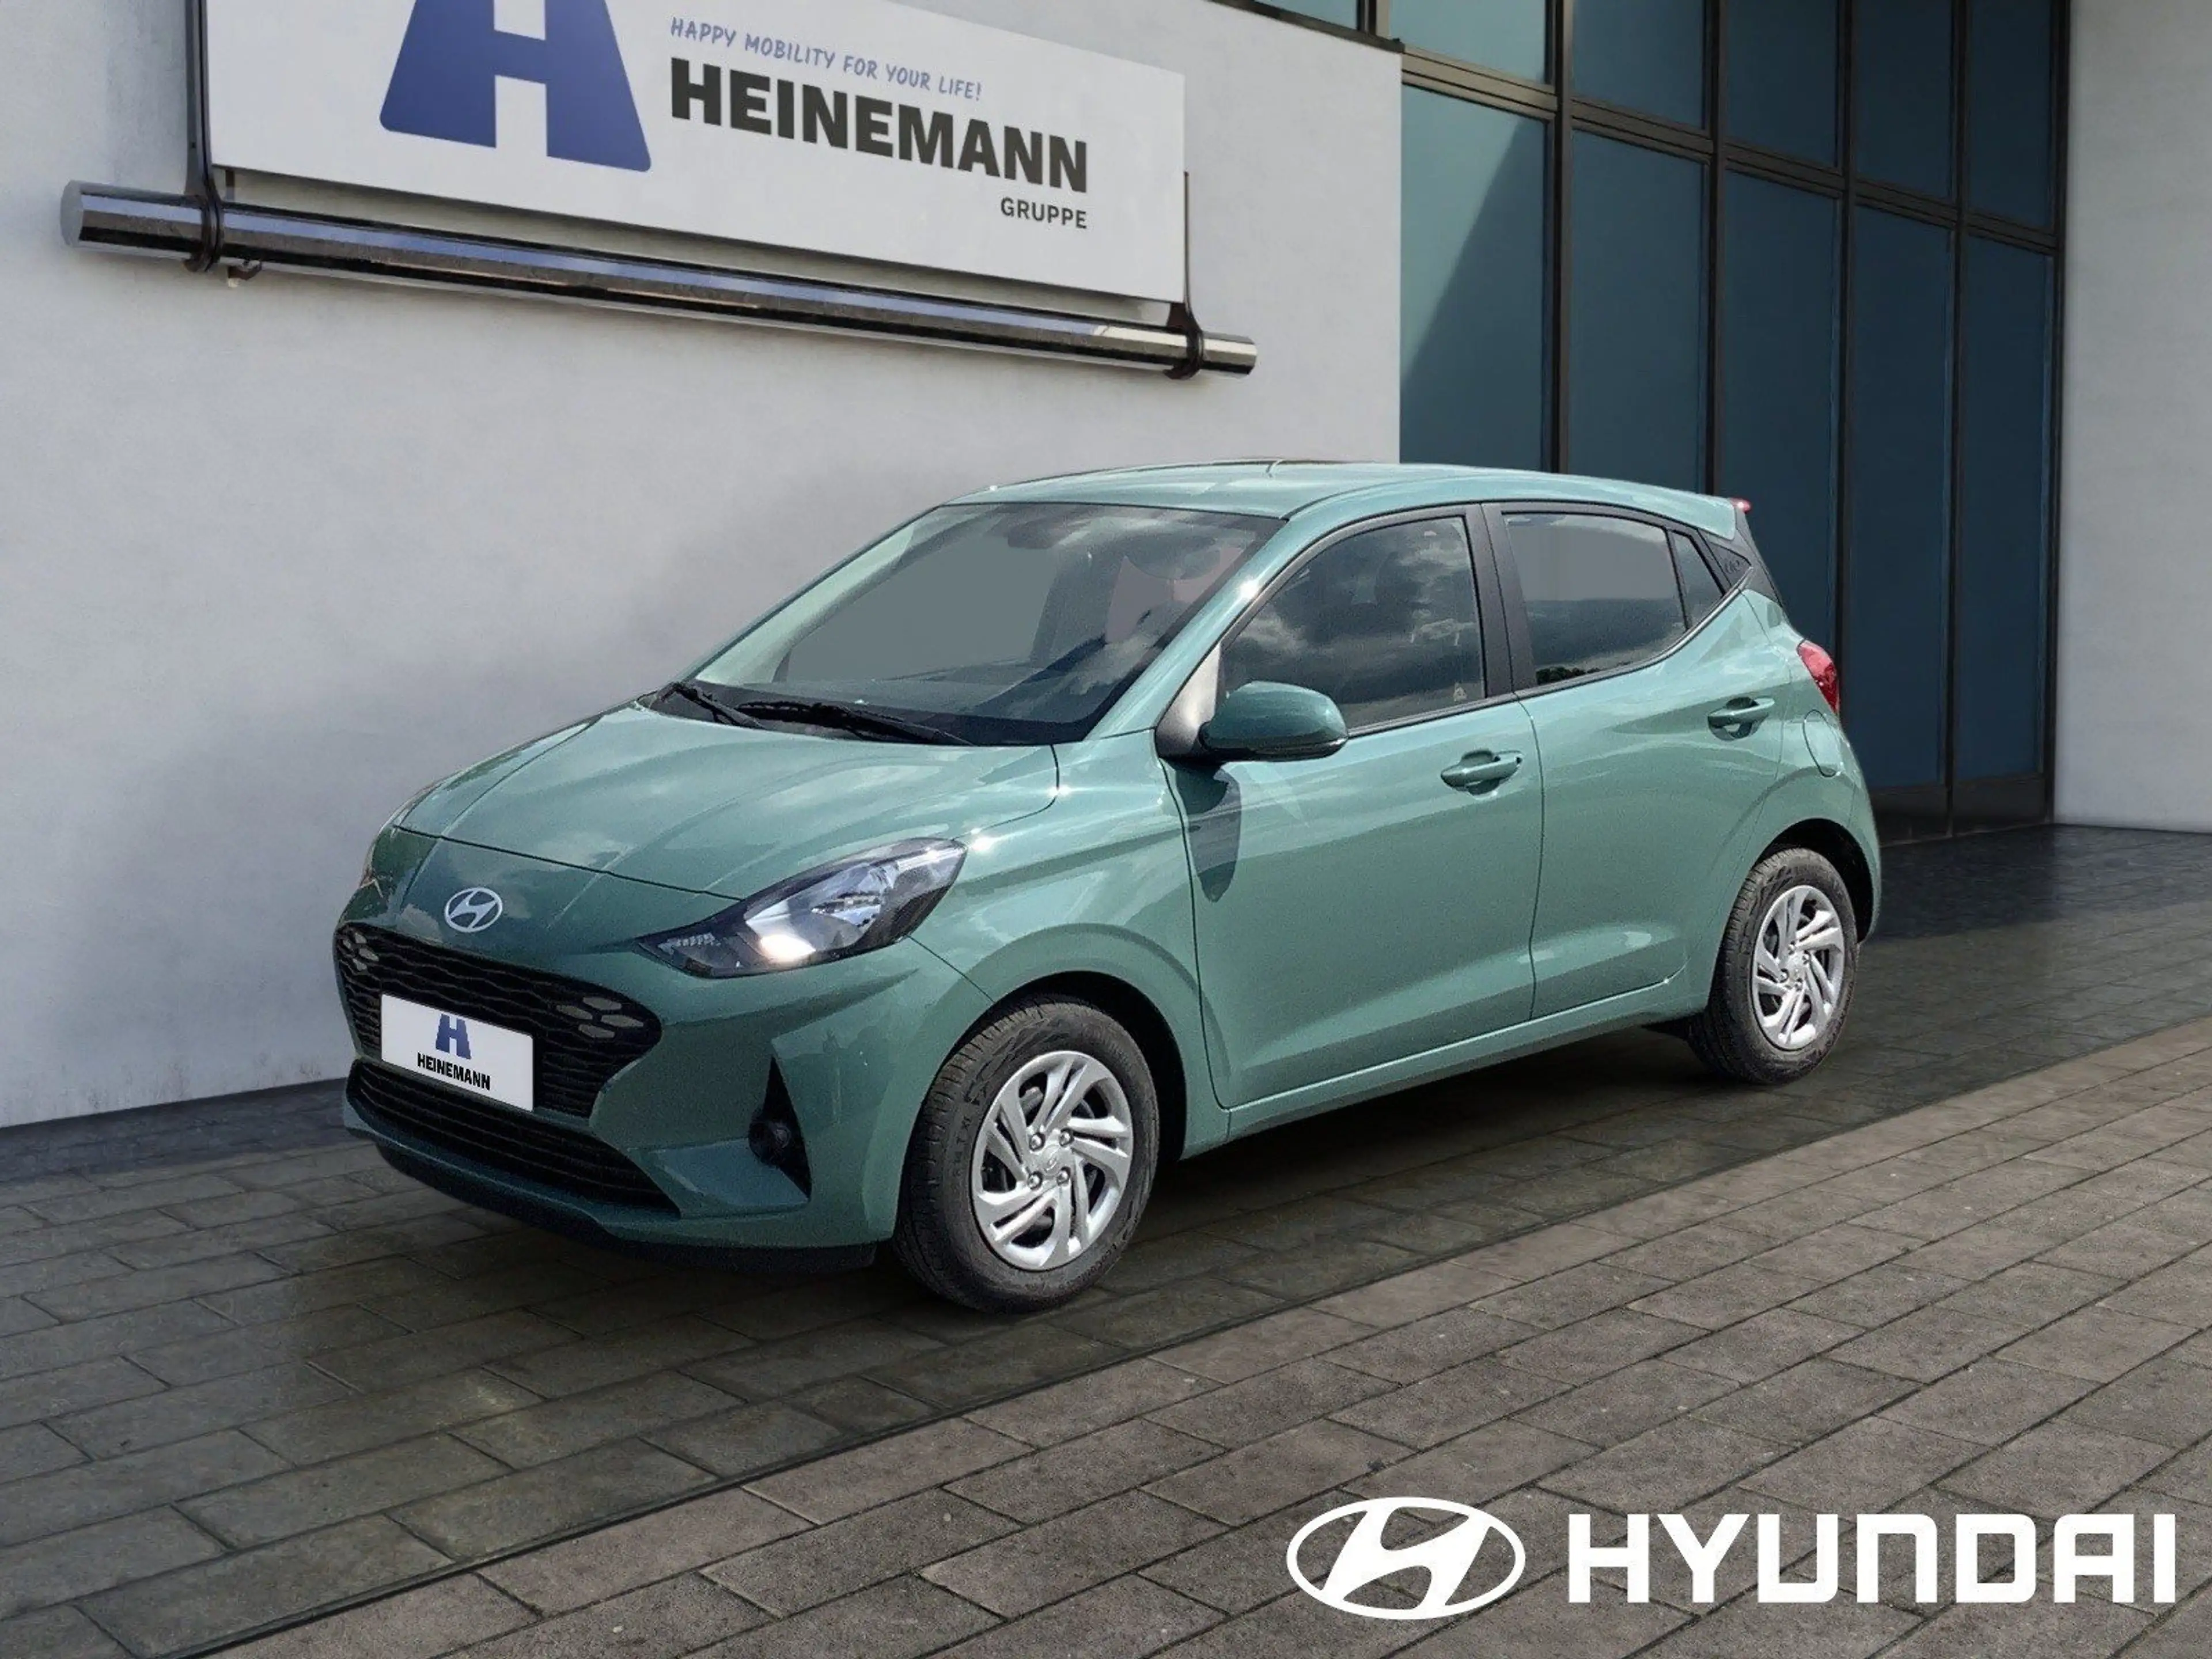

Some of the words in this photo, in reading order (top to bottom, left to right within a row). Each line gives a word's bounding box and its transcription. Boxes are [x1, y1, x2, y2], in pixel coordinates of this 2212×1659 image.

[671, 17, 737, 47] HAPPY
[744, 33, 835, 69] MOBILITY
[843, 55, 878, 79] FOR
[886, 63, 930, 90] YOUR
[938, 75, 982, 101] LIFE!
[671, 57, 1087, 193] HEINEMANN
[1001, 196, 1088, 229] GRUPPE
[417, 1052, 491, 1090] HEINEMANN
